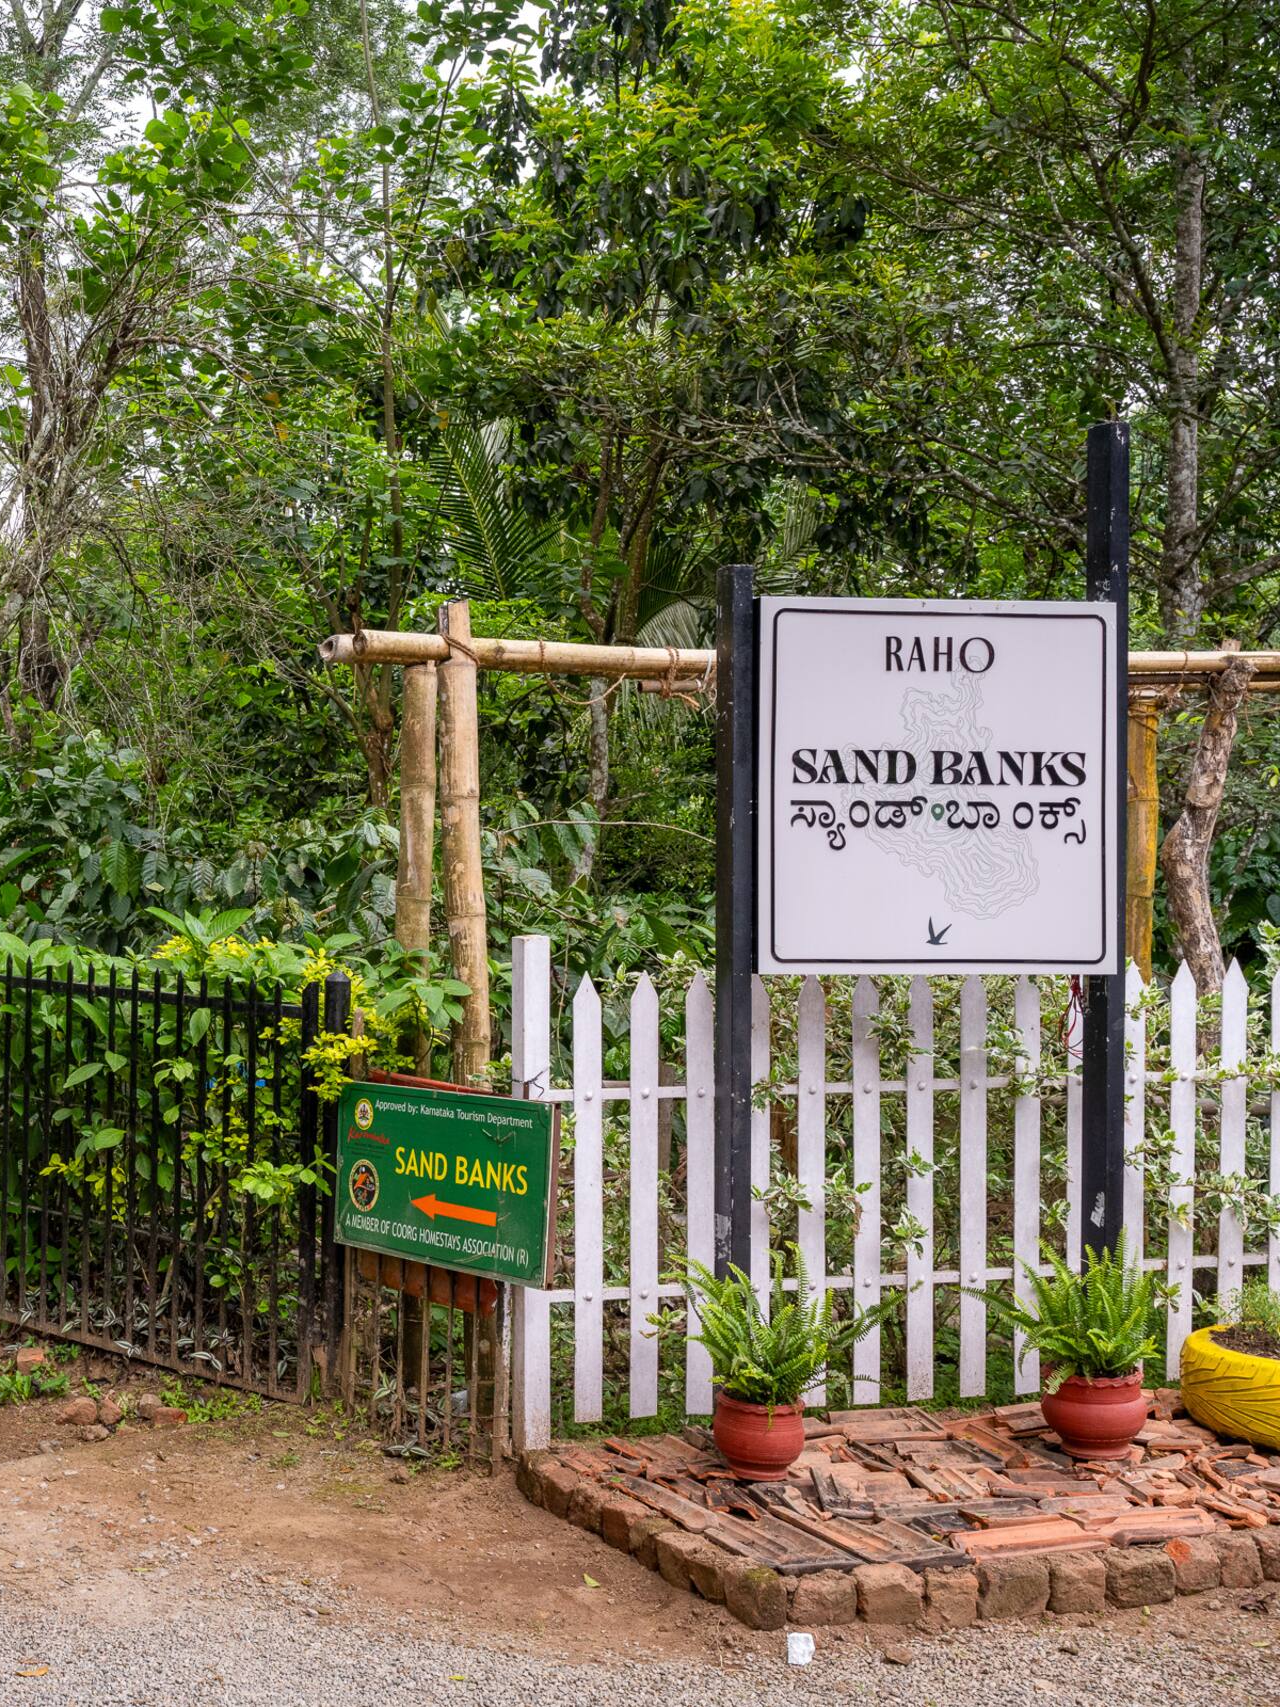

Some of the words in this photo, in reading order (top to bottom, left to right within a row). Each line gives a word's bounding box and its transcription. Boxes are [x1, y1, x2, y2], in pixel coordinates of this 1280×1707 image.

[885, 636, 995, 673] RAHO
[791, 748, 918, 785] SAND
[929, 750, 1087, 786] BANKS
[375, 1098, 406, 1112] Approved
[408, 1103, 419, 1116] by:
[420, 1104, 455, 1119] Karnataka
[456, 1108, 486, 1122] Tourism
[487, 1112, 533, 1129] Department
[395, 1146, 448, 1181] SAND
[455, 1156, 528, 1195] BANKS
[345, 1212, 351, 1226] A
[351, 1214, 380, 1233] MEMBER
[380, 1220, 391, 1235] OF
[392, 1222, 418, 1241] COORG
[419, 1228, 461, 1251] HOMESTAYS
[462, 1237, 515, 1263] ASSOCIATION
[516, 1248, 529, 1269] (R)
